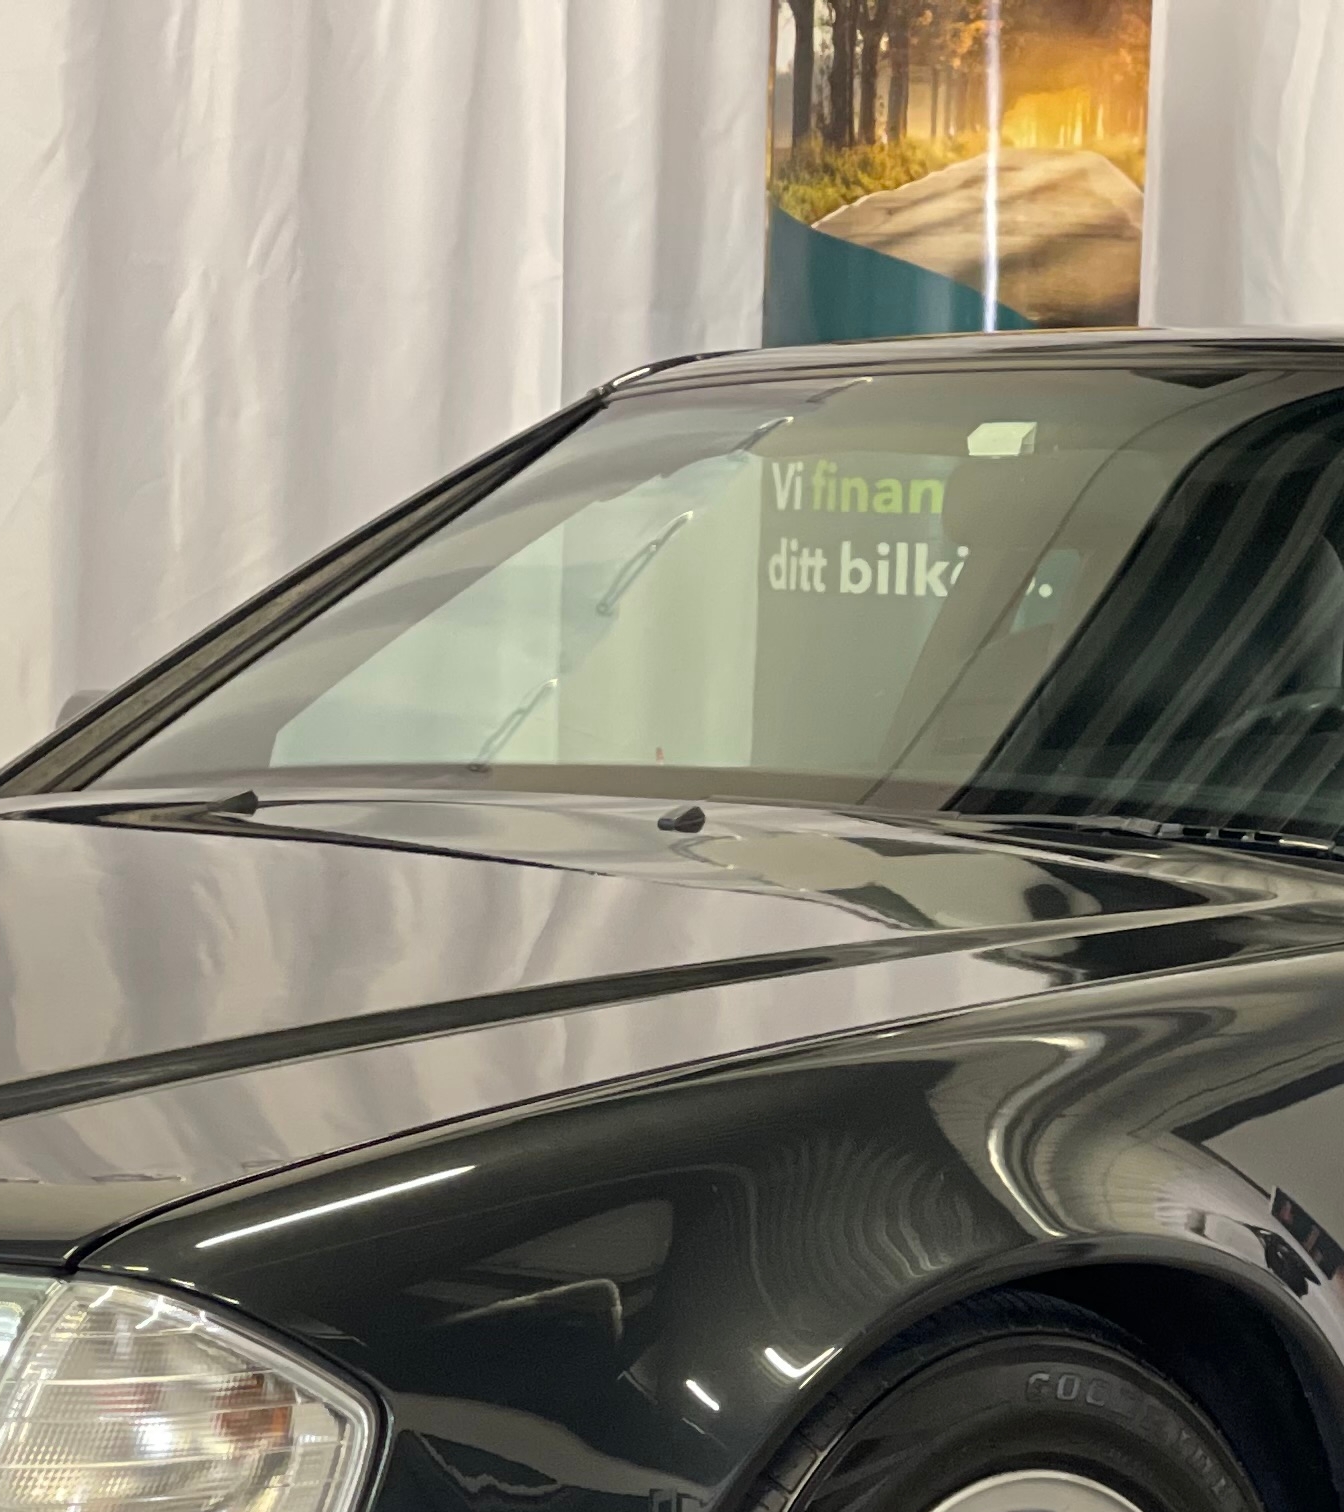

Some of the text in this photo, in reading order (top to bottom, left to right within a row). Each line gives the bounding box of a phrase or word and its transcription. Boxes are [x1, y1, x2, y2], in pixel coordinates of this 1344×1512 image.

[772, 459, 945, 514] Vi finan
[768, 537, 828, 593] ditt
